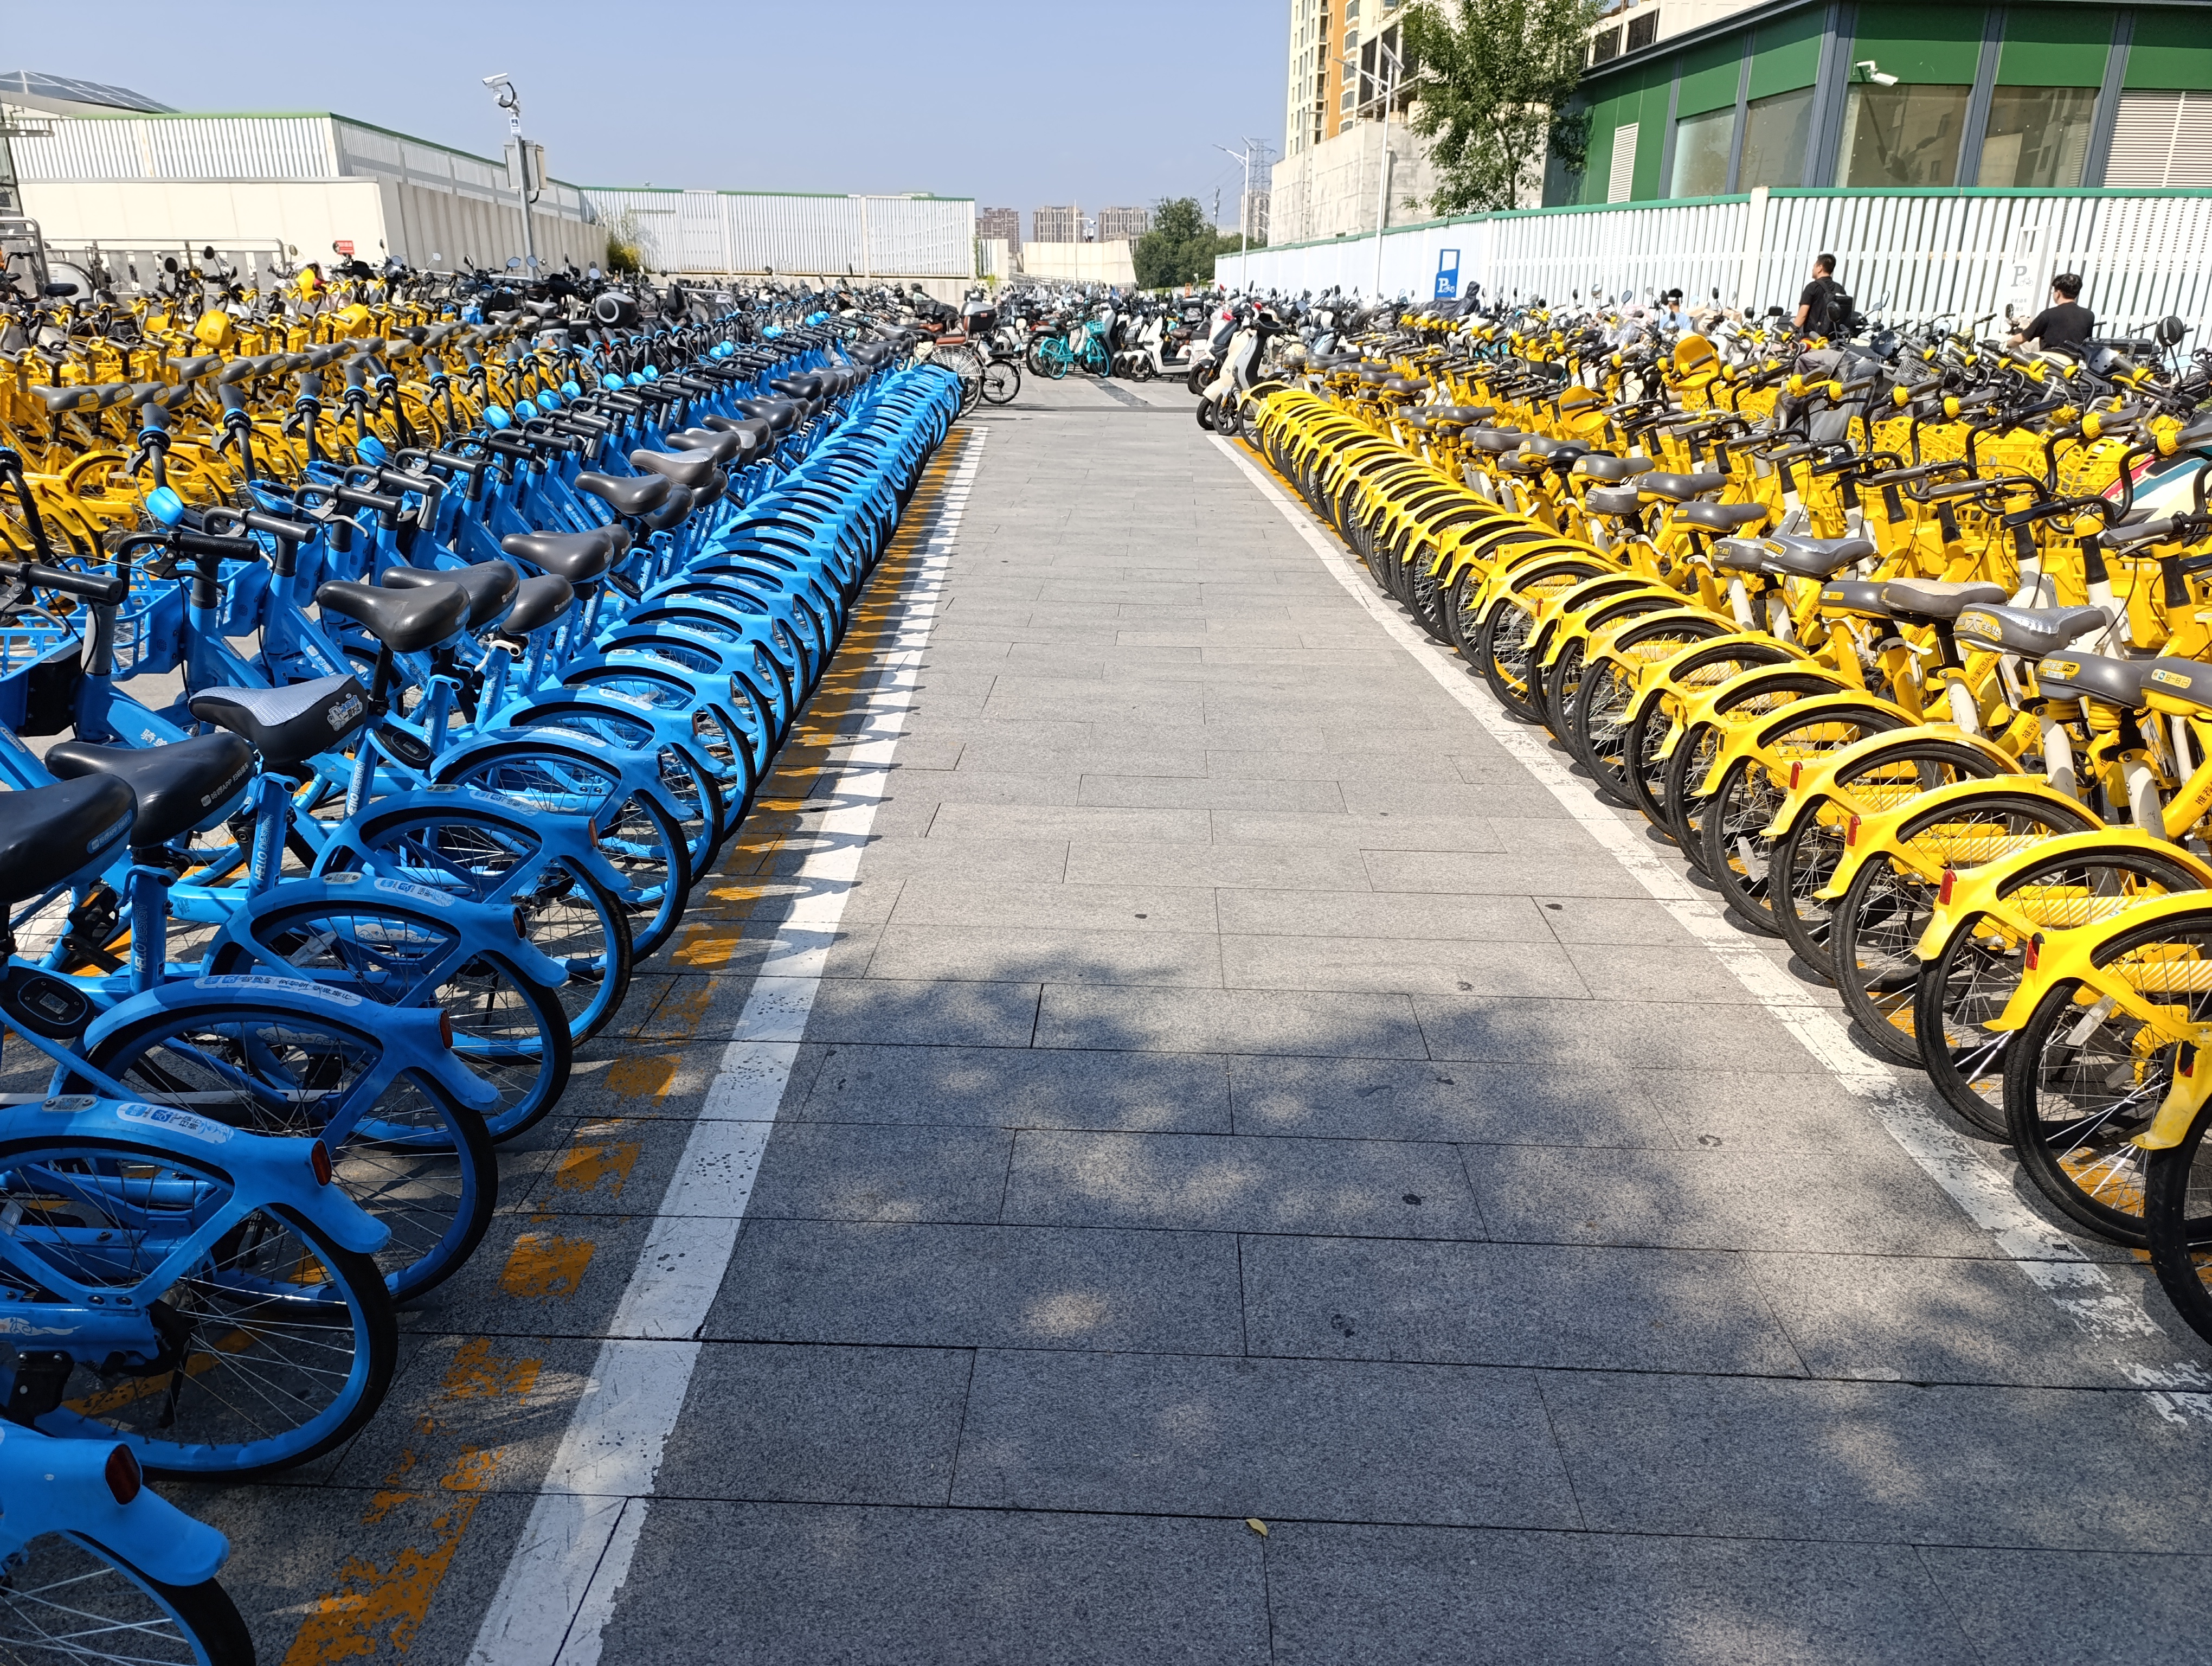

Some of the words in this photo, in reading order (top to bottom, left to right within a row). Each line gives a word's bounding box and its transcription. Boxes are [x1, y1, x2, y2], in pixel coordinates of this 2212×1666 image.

[1437, 278, 1449, 293] P
[2010, 265, 2027, 287] P
[352, 759, 366, 793] DESIGN
[258, 812, 274, 851] DESIGN
[254, 851, 268, 881] HELLO
[136, 901, 148, 942] DESIGN
[134, 943, 147, 974] HELLO
